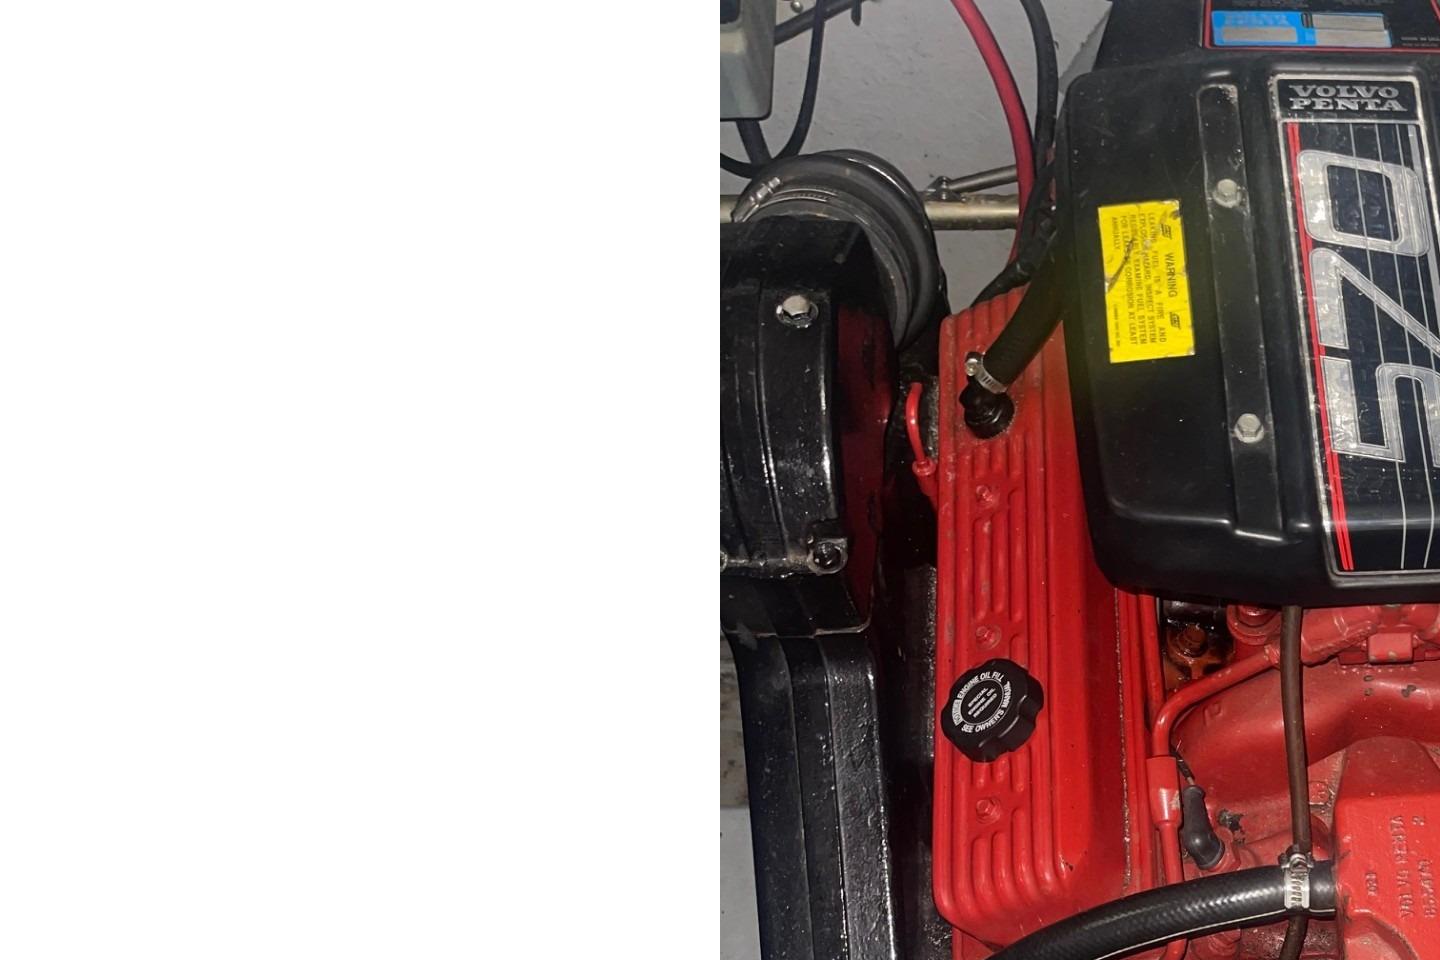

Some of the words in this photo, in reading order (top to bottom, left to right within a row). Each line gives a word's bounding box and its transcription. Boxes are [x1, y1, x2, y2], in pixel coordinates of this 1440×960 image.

[1288, 85, 1399, 98] VOLVO
[1288, 97, 1408, 111] PENTA
[1152, 250, 1160, 269] FUEL
[1133, 257, 1143, 292] EXAMINE
[1165, 252, 1178, 298] WARNING
[1136, 293, 1144, 312] FUEL
[1145, 284, 1154, 312] INSPECT
[1156, 302, 1164, 320] FIRE
[1129, 323, 1138, 346] LEAST
[1137, 314, 1147, 345] SYSTEM
[1147, 315, 1157, 344] SYSTEM
[1158, 326, 1167, 343] AND
[957, 675, 979, 699] ENGINE
[980, 671, 991, 680] OIL
[991, 671, 1004, 682] FILL
[961, 723, 974, 733] SEE
[1001, 680, 1011, 708] MANUAL
